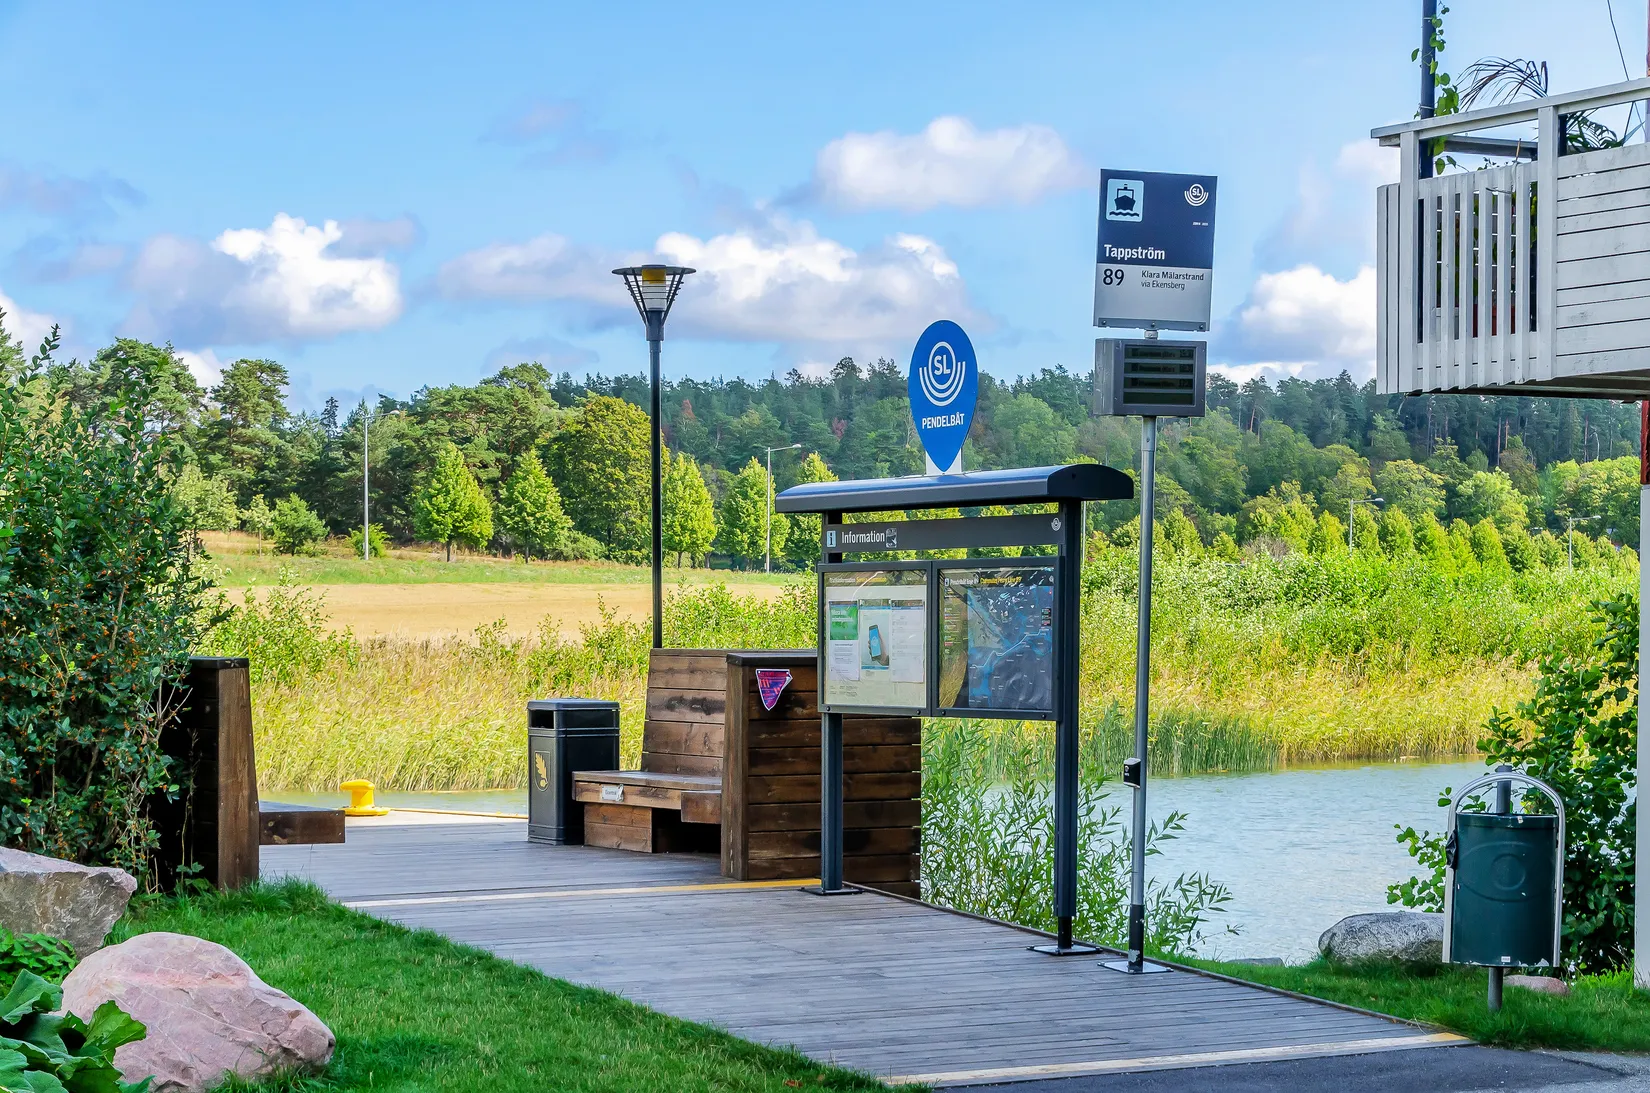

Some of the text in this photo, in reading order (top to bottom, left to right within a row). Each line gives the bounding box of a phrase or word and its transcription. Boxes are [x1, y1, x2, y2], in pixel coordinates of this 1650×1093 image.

[1104, 244, 1165, 260] Tappström
[1103, 269, 1124, 286] 89
[1162, 271, 1204, 280] Mälarstrand
[1152, 281, 1185, 291] Ekensberg
[934, 355, 951, 374] SL
[922, 412, 965, 429] PENDELBÅT
[842, 531, 885, 543] Information
